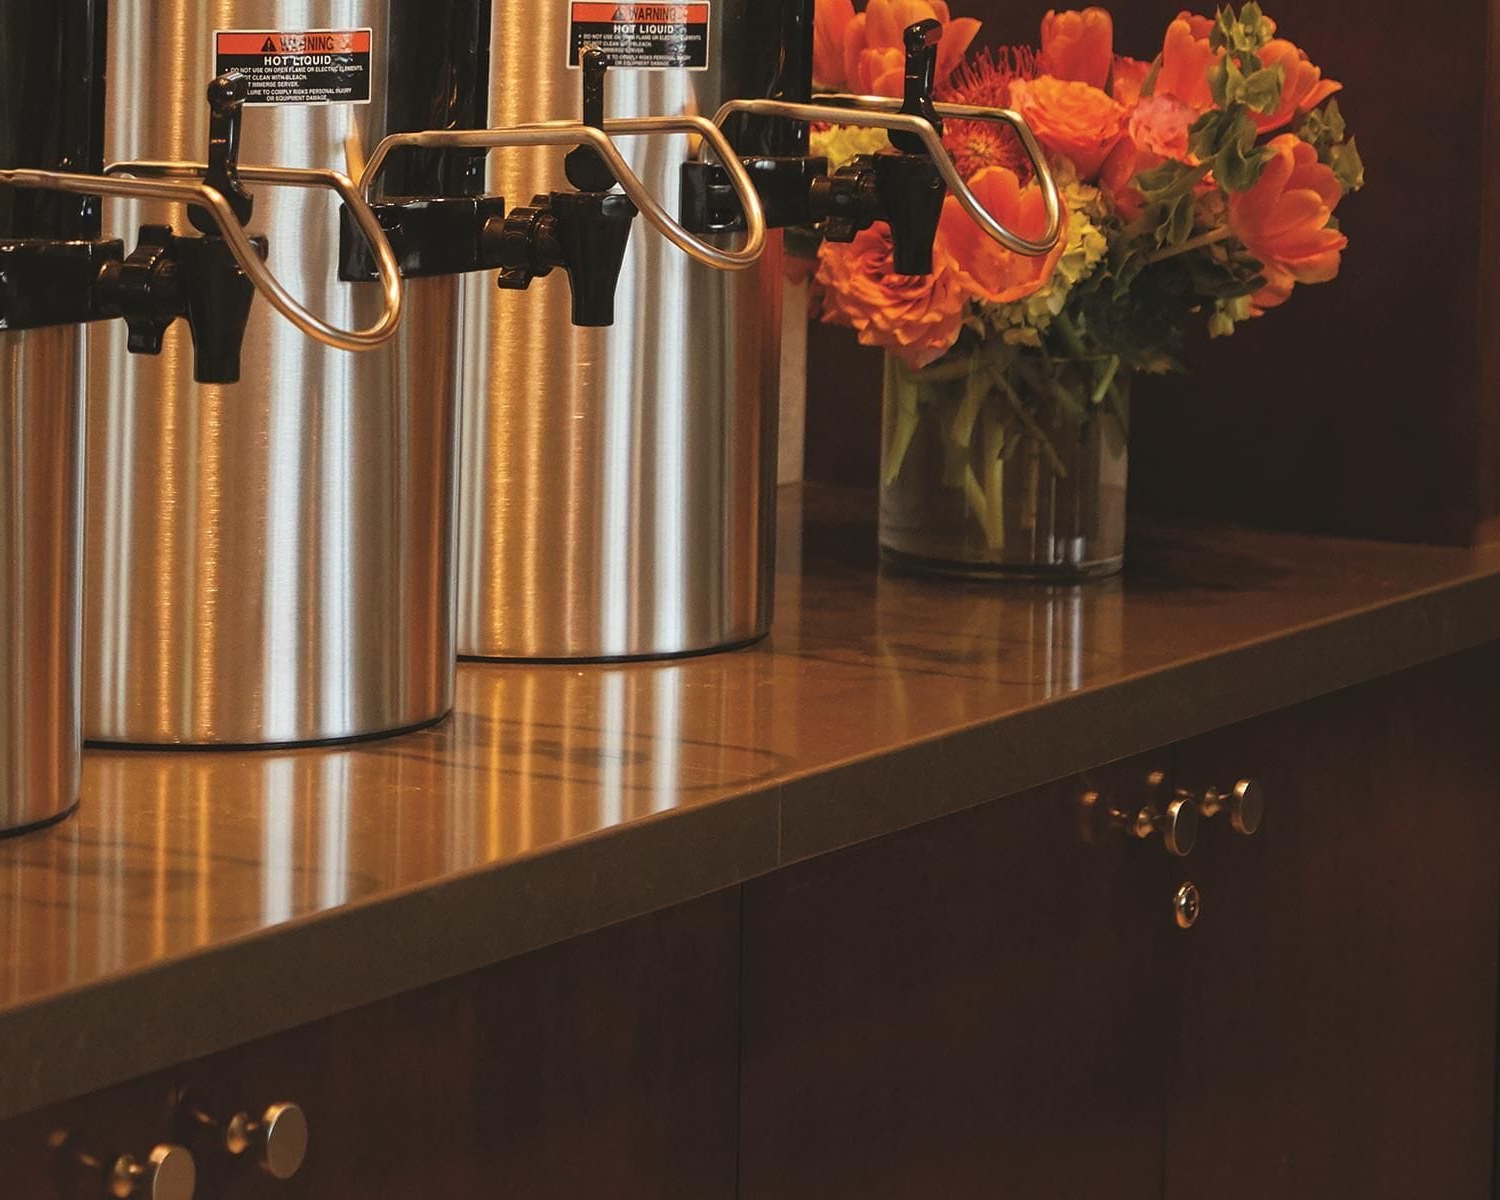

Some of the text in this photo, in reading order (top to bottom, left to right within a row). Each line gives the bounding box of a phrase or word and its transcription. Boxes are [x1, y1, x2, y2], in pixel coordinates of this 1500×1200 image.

[628, 7, 676, 21] WARNING
[613, 24, 674, 34] HOT LIQUID
[280, 36, 334, 51] WNING
[264, 55, 332, 66] HOT LIQUID
